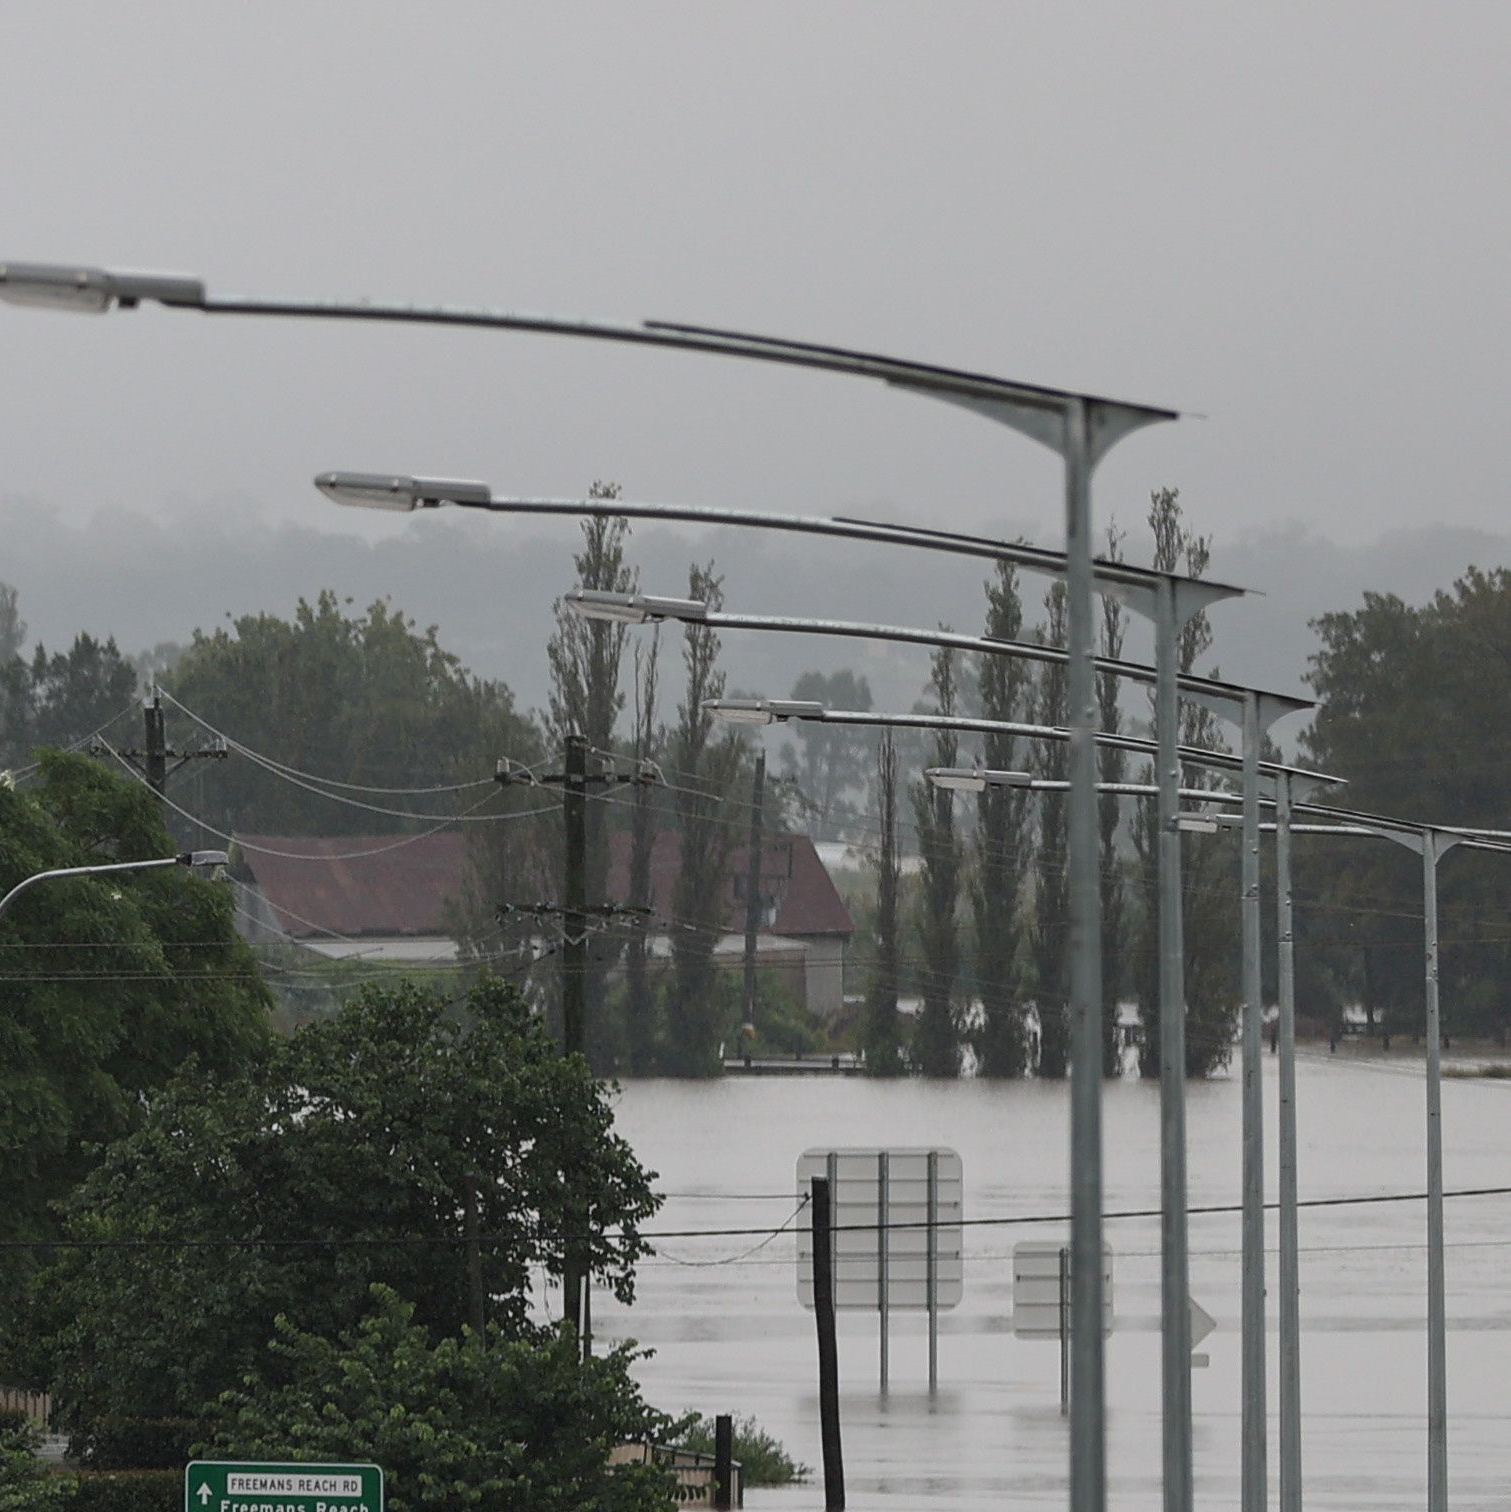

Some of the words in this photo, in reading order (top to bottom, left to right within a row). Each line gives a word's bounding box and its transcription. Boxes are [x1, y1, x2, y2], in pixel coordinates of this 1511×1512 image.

[230, 1478, 293, 1491] FREEMANS
[298, 1480, 337, 1492] REACH
[343, 1480, 358, 1492] RD
